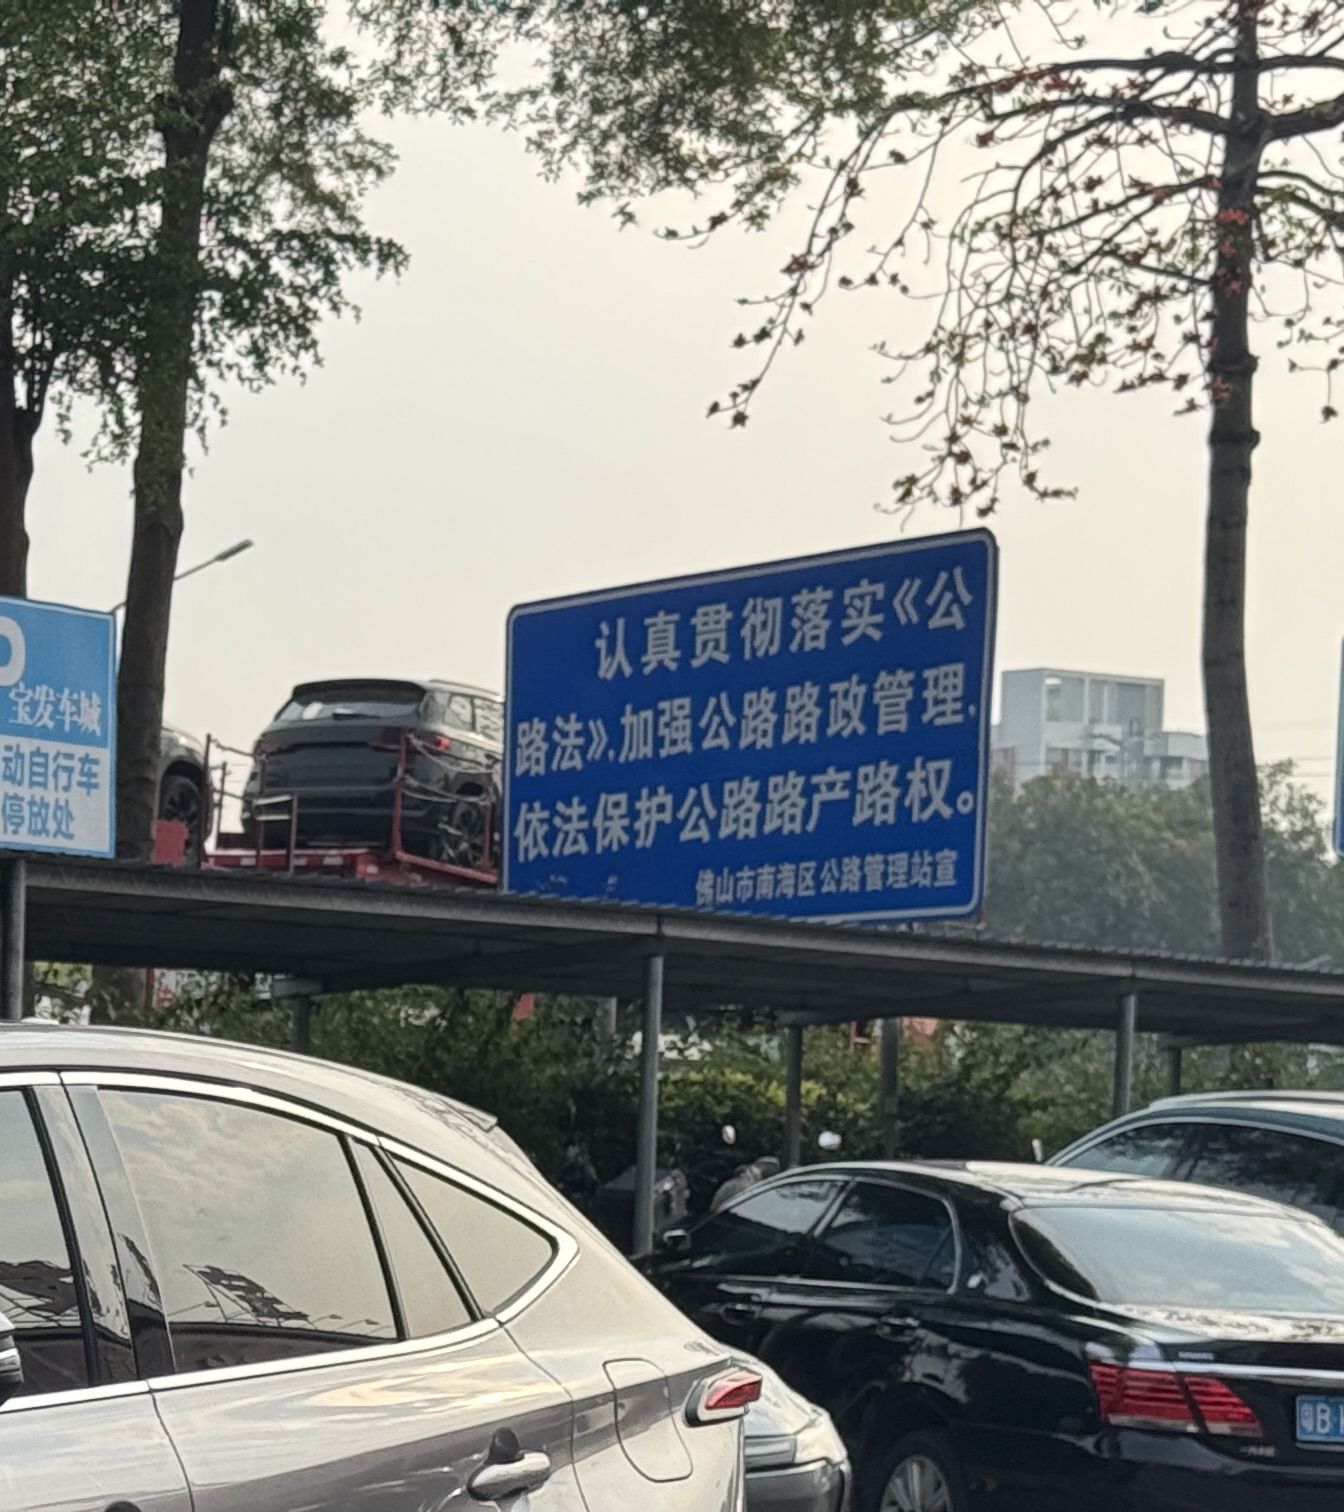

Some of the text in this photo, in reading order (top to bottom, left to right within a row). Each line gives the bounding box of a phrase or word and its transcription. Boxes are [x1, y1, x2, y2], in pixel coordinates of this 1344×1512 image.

[595, 566, 973, 680] 认真贯彻落实《公
[9, 681, 101, 736] 宝发车城
[2, 792, 74, 840] 停放处
[514, 755, 974, 863] 依法保护公路路产路权。
[695, 849, 957, 905] 佛山市南海区公路管理站宣
